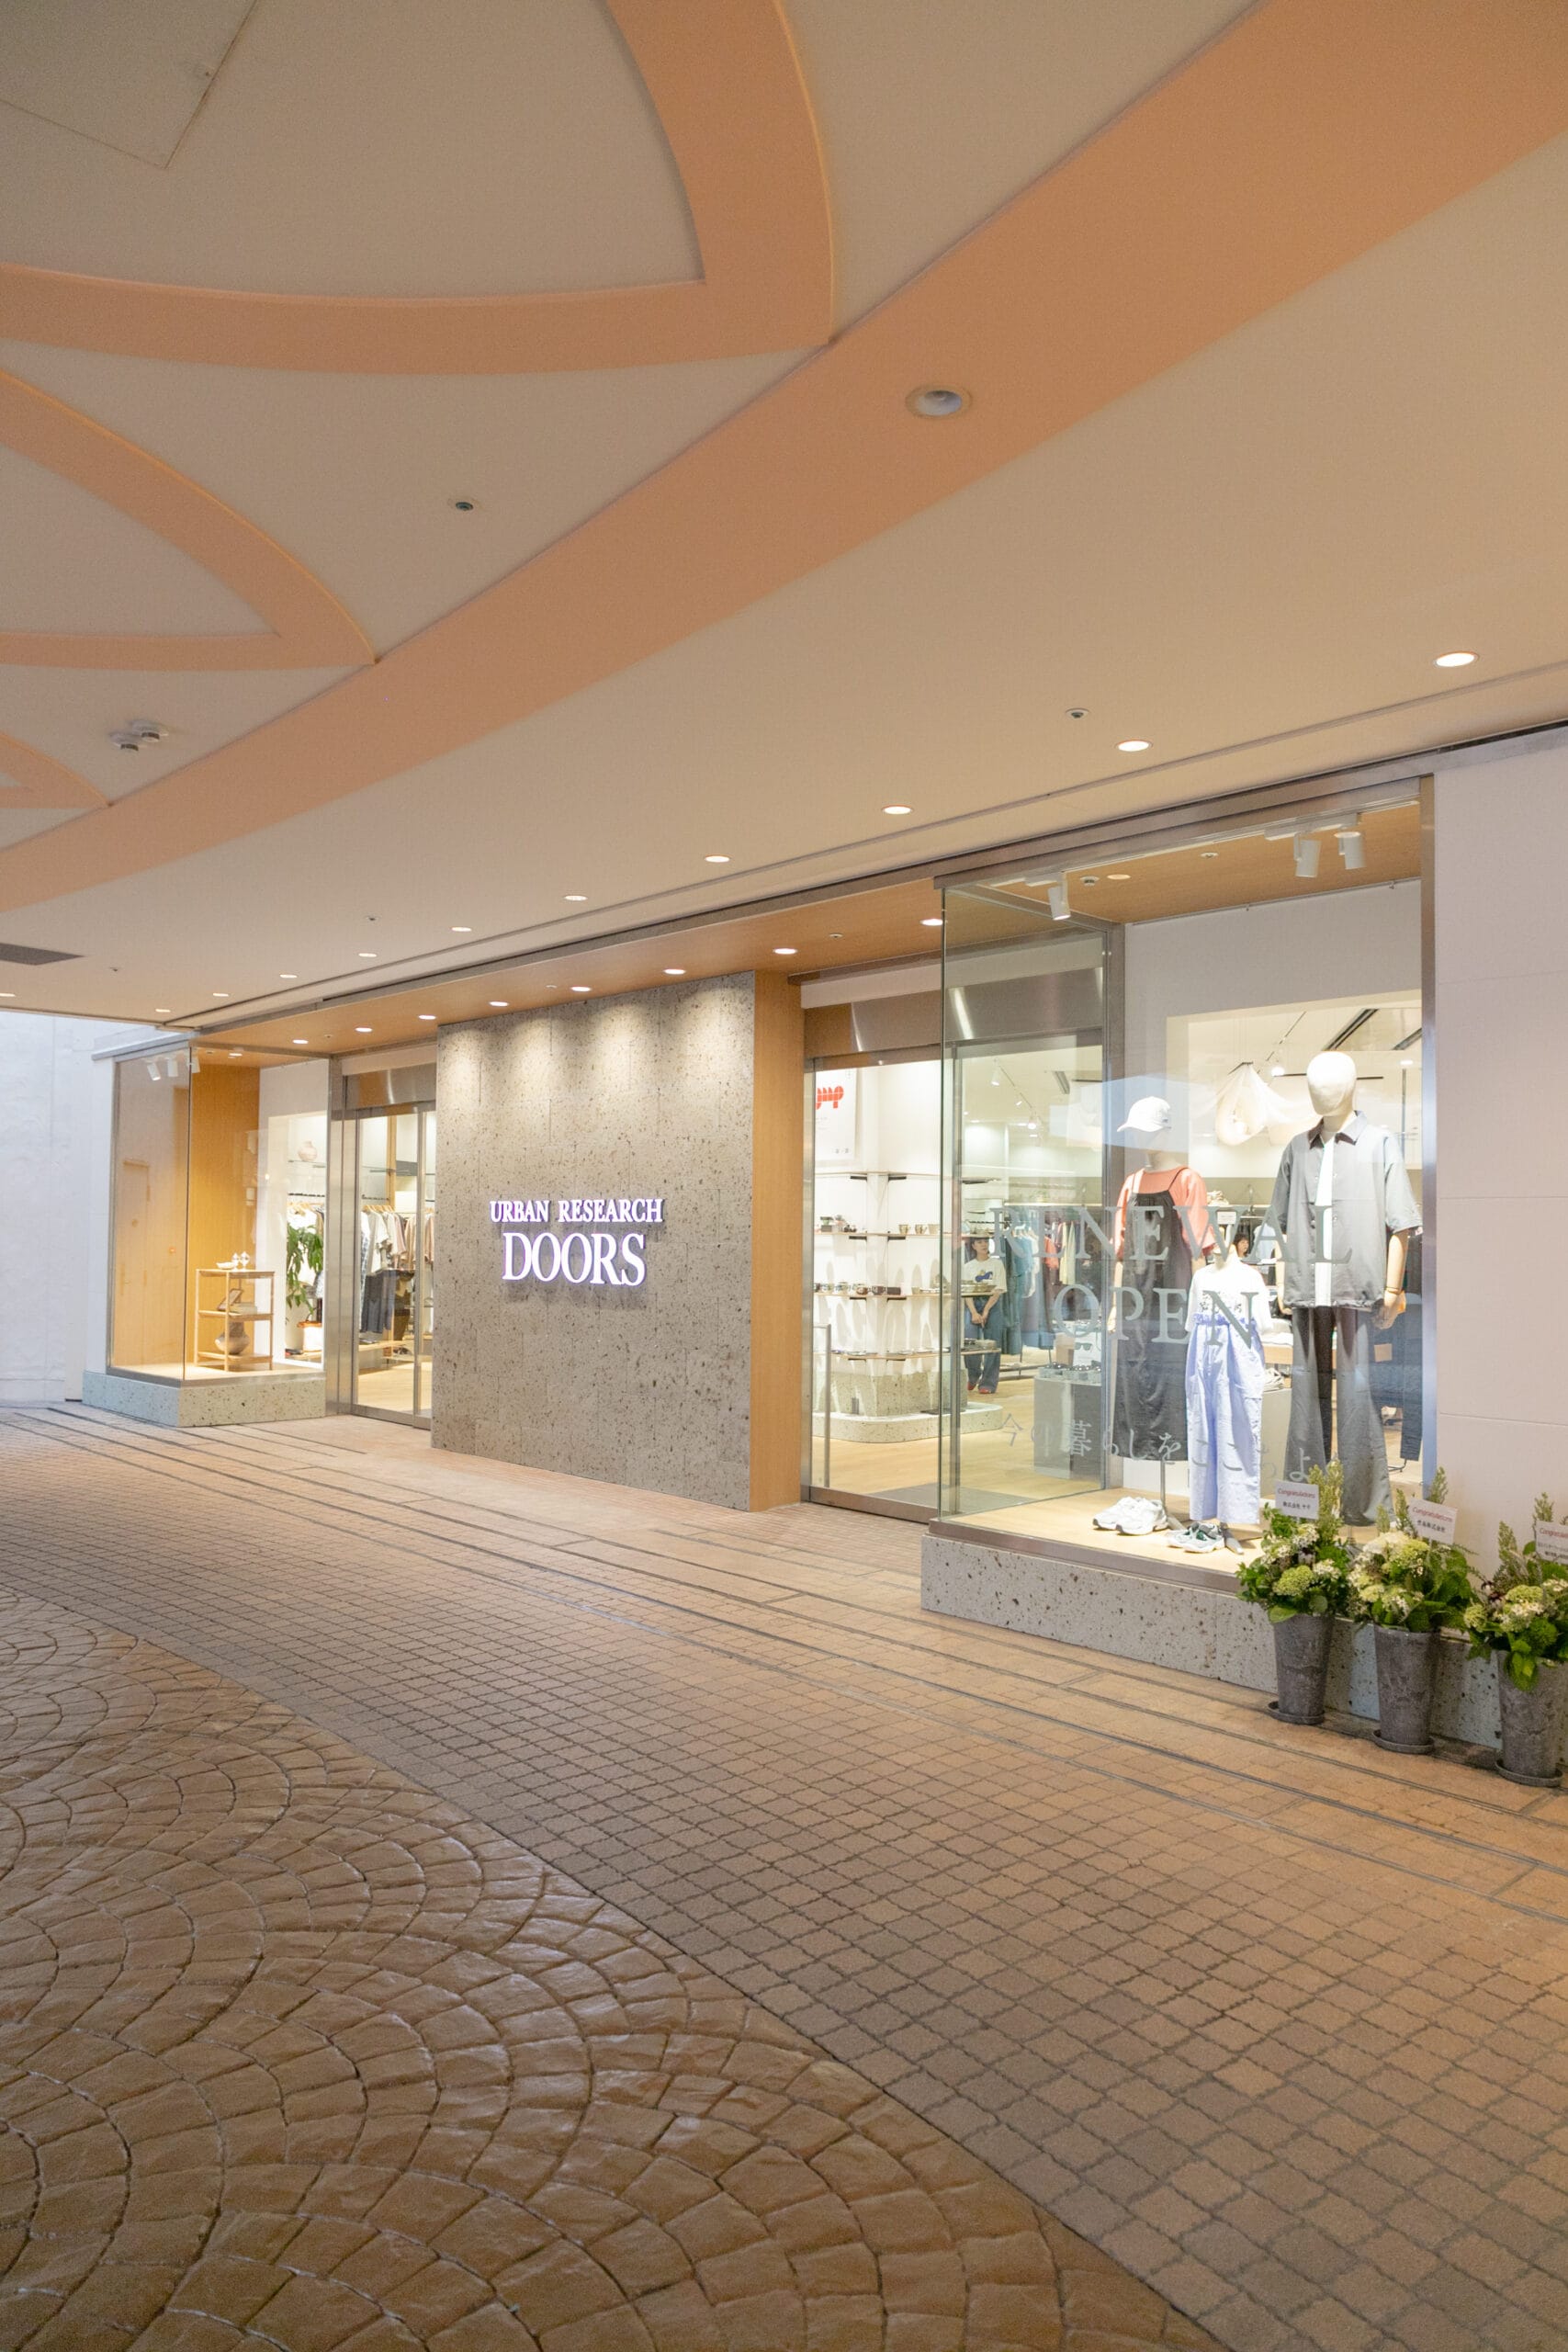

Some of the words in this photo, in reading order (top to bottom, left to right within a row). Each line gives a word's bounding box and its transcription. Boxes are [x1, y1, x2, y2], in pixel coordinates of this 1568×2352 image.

[490, 1200, 550, 1223] URBAN
[558, 1198, 664, 1223] RESEARCH
[989, 1204, 1352, 1264] RENEWAL
[502, 1231, 646, 1286] DOORS
[1055, 1283, 1259, 1350] OPEN
